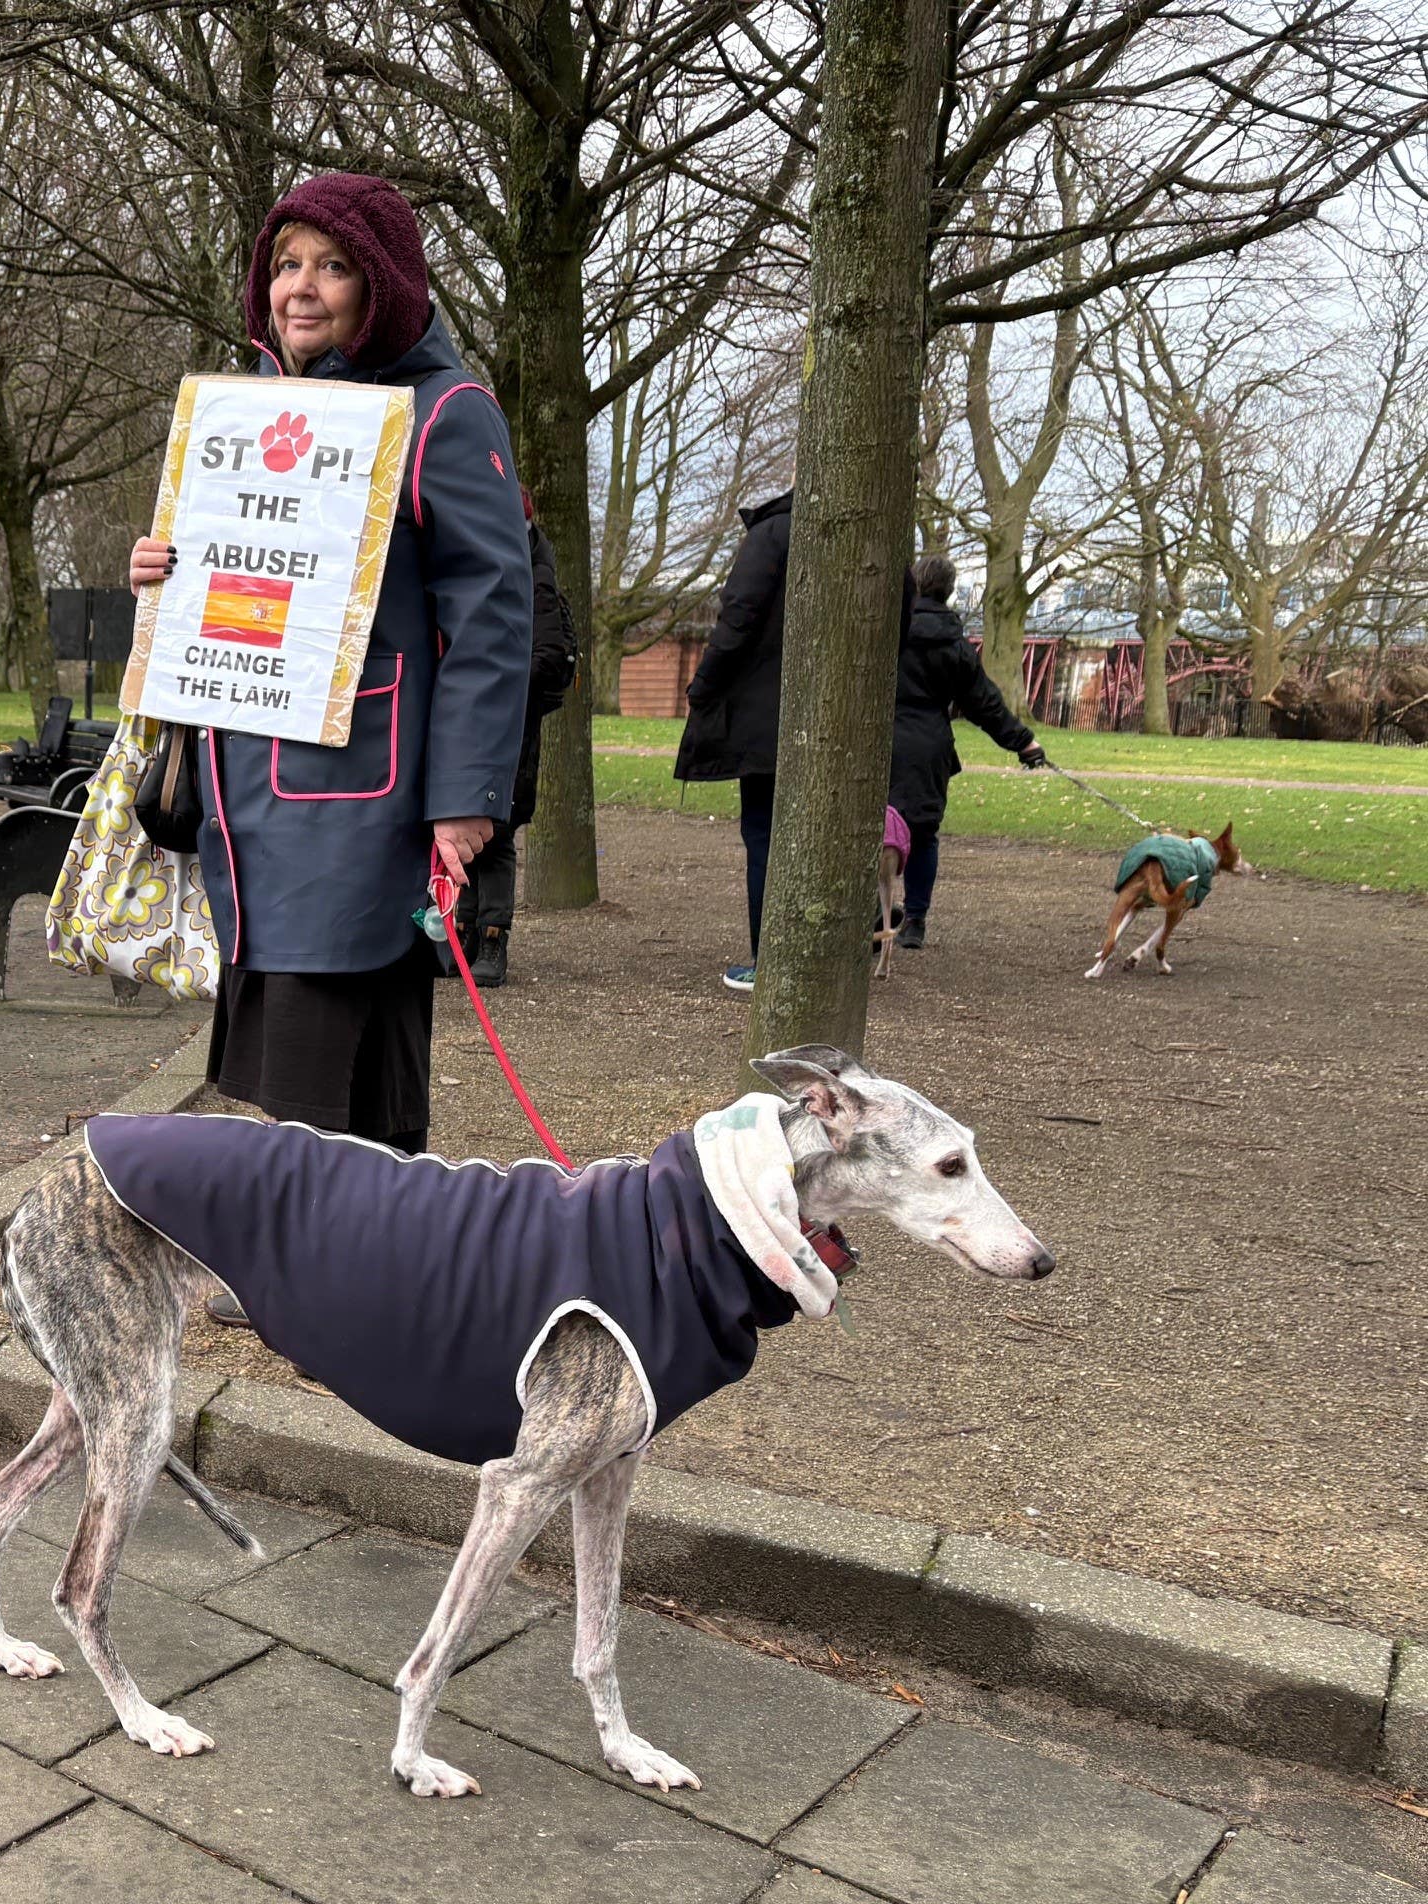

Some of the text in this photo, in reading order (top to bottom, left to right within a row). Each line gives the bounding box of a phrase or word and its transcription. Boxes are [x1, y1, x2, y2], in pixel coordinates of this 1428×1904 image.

[237, 492, 301, 524] THE
[200, 542, 319, 579] ABUSE!
[184, 645, 286, 678] CHANGE
[177, 675, 291, 710] THE LAW!
